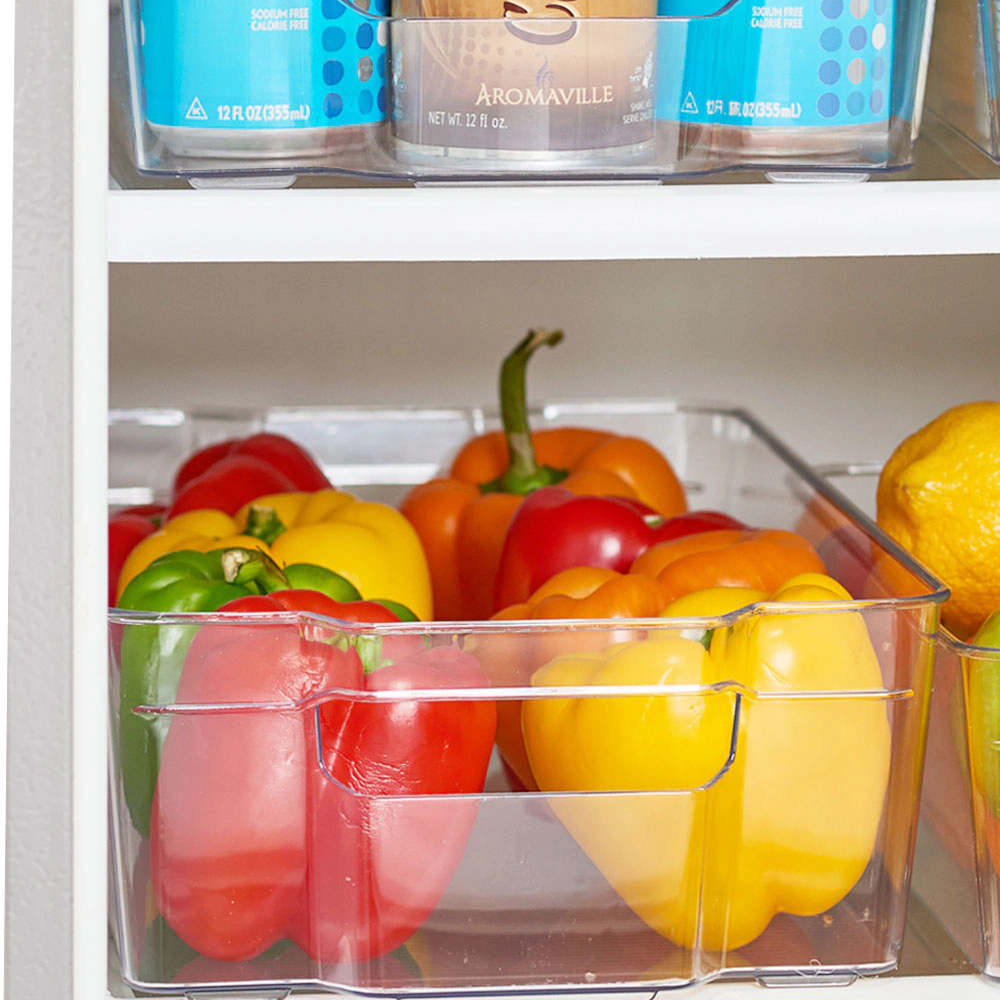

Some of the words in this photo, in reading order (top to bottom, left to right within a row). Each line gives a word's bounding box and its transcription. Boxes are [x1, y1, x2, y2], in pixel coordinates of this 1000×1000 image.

[251, 8, 288, 19] SODIUM
[289, 8, 309, 19] FREE
[783, 6, 804, 17] FREE
[251, 20, 288, 31] CALORIE
[289, 20, 309, 31] FREE
[783, 17, 804, 29] FREE
[475, 83, 614, 107] AROMAVILLE
[217, 105, 231, 120] 12
[232, 105, 244, 120] FL
[245, 105, 262, 120] OZ
[428, 111, 445, 125] NET
[448, 112, 463, 126] WT.
[465, 113, 477, 127] 12
[491, 117, 508, 129] oz.
